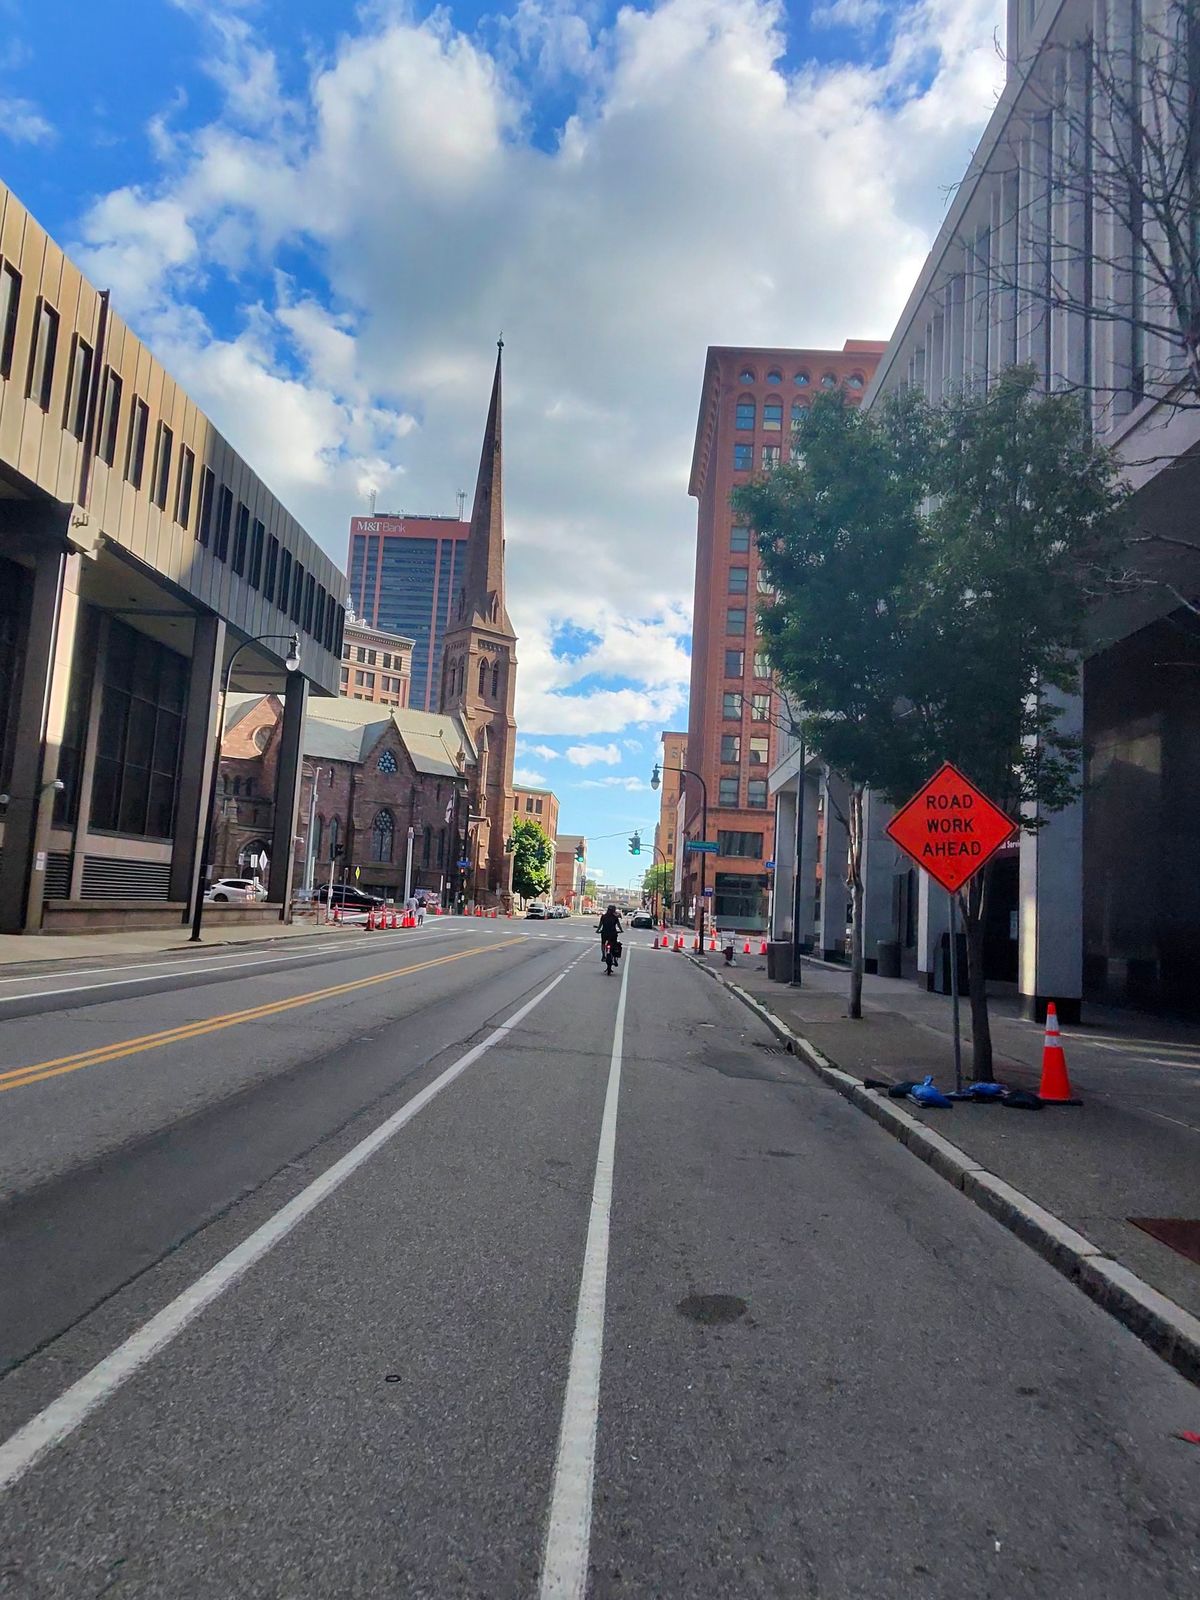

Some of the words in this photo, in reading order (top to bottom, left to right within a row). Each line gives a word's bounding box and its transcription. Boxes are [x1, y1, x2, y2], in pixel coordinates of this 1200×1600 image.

[357, 521, 382, 532] M&T
[383, 521, 406, 533] Bank
[926, 794, 973, 809] ROAD
[927, 818, 974, 833] WORK
[923, 841, 981, 856] AHEAD
